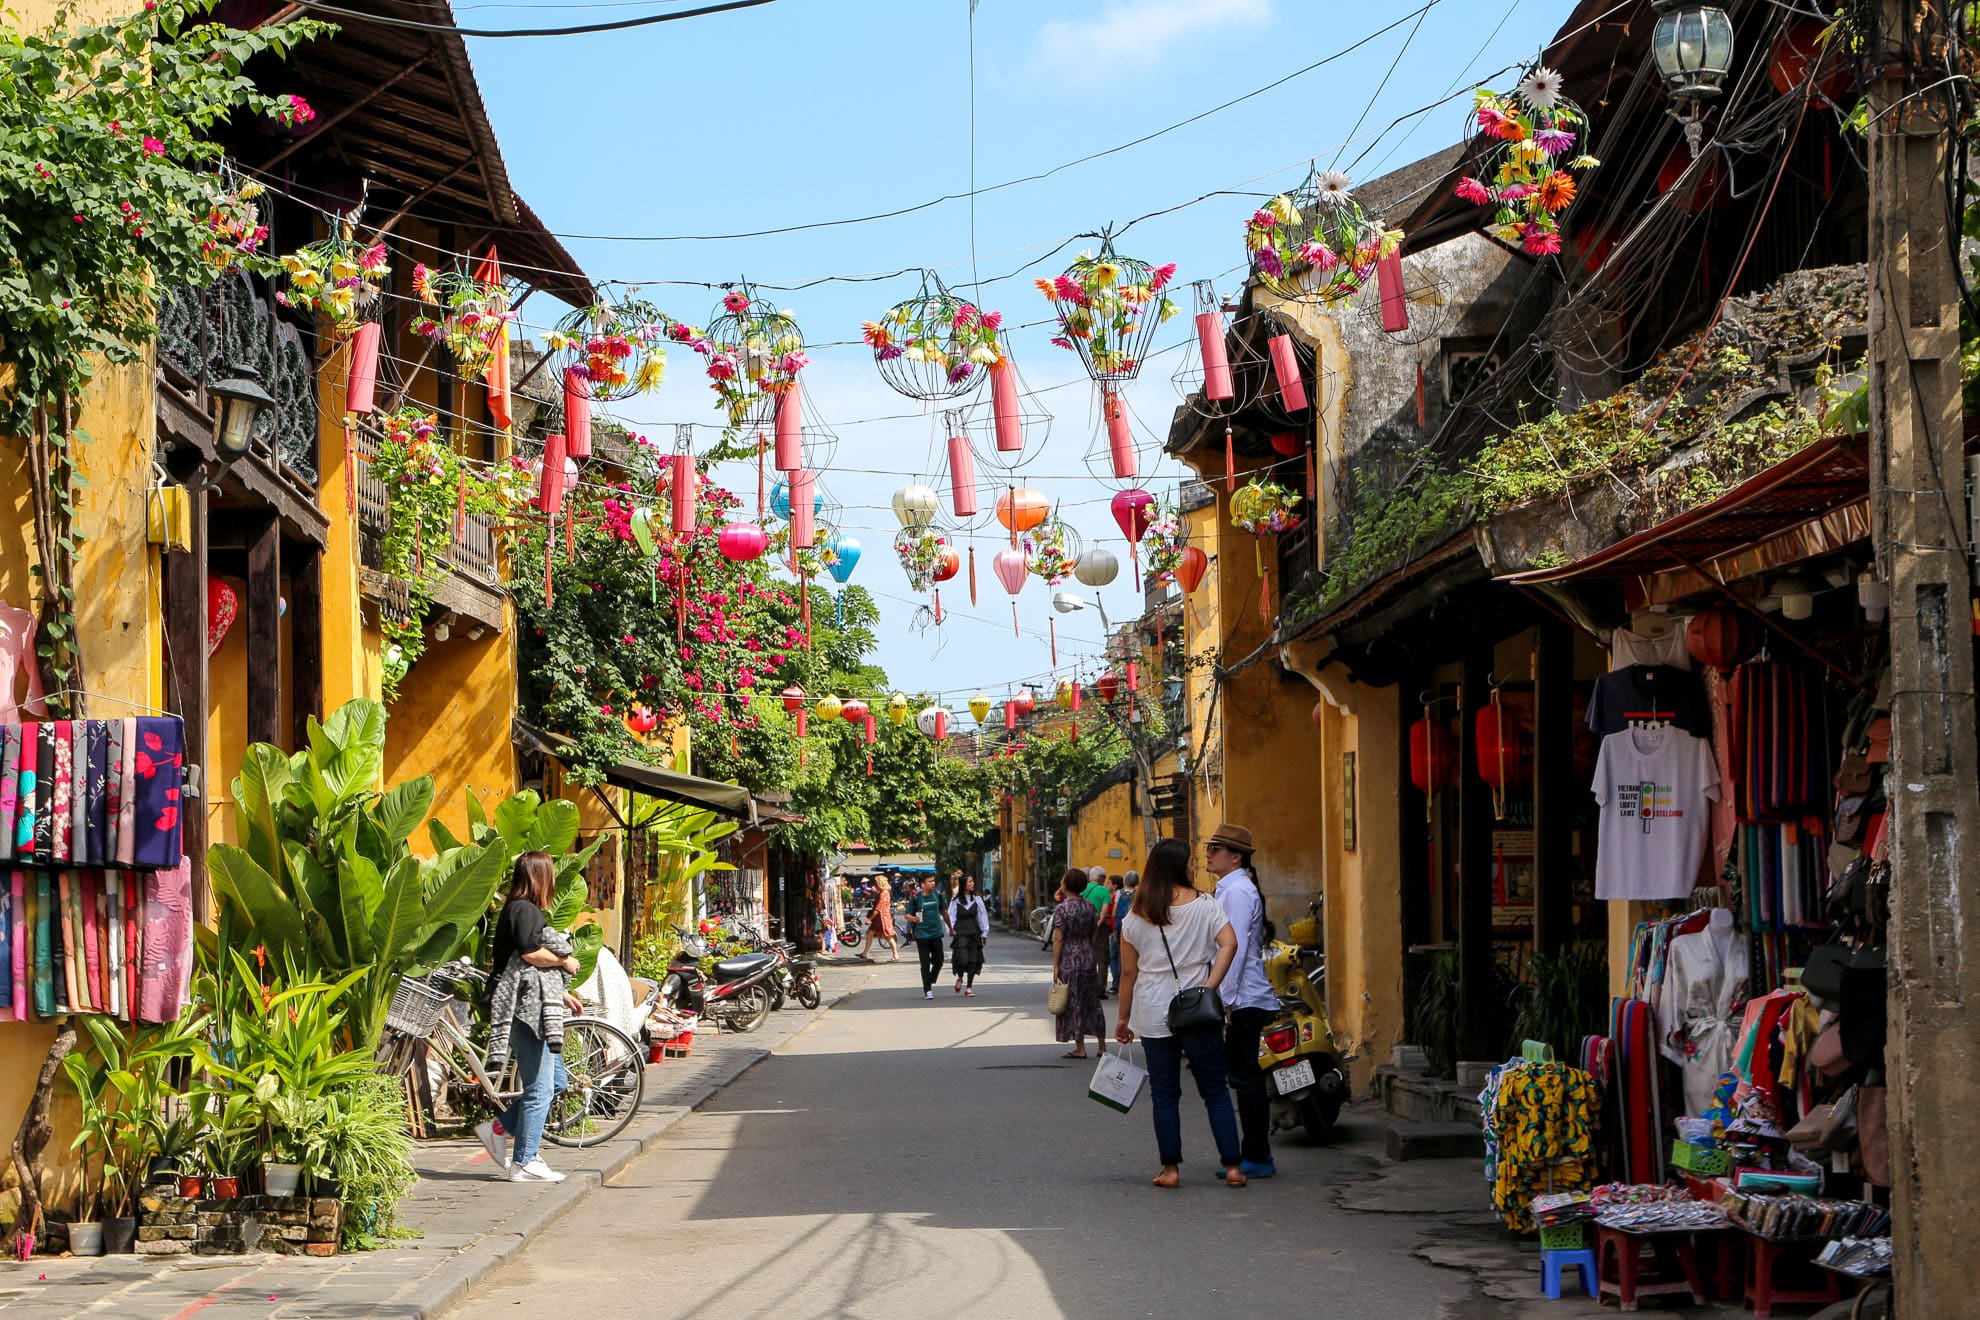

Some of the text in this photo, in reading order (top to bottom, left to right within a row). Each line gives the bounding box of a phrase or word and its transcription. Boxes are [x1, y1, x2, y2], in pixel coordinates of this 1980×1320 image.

[1617, 784, 1640, 792] VIETNAM
[1619, 792, 1638, 800] TRAFFIC
[1620, 809, 1635, 817] LAWS
